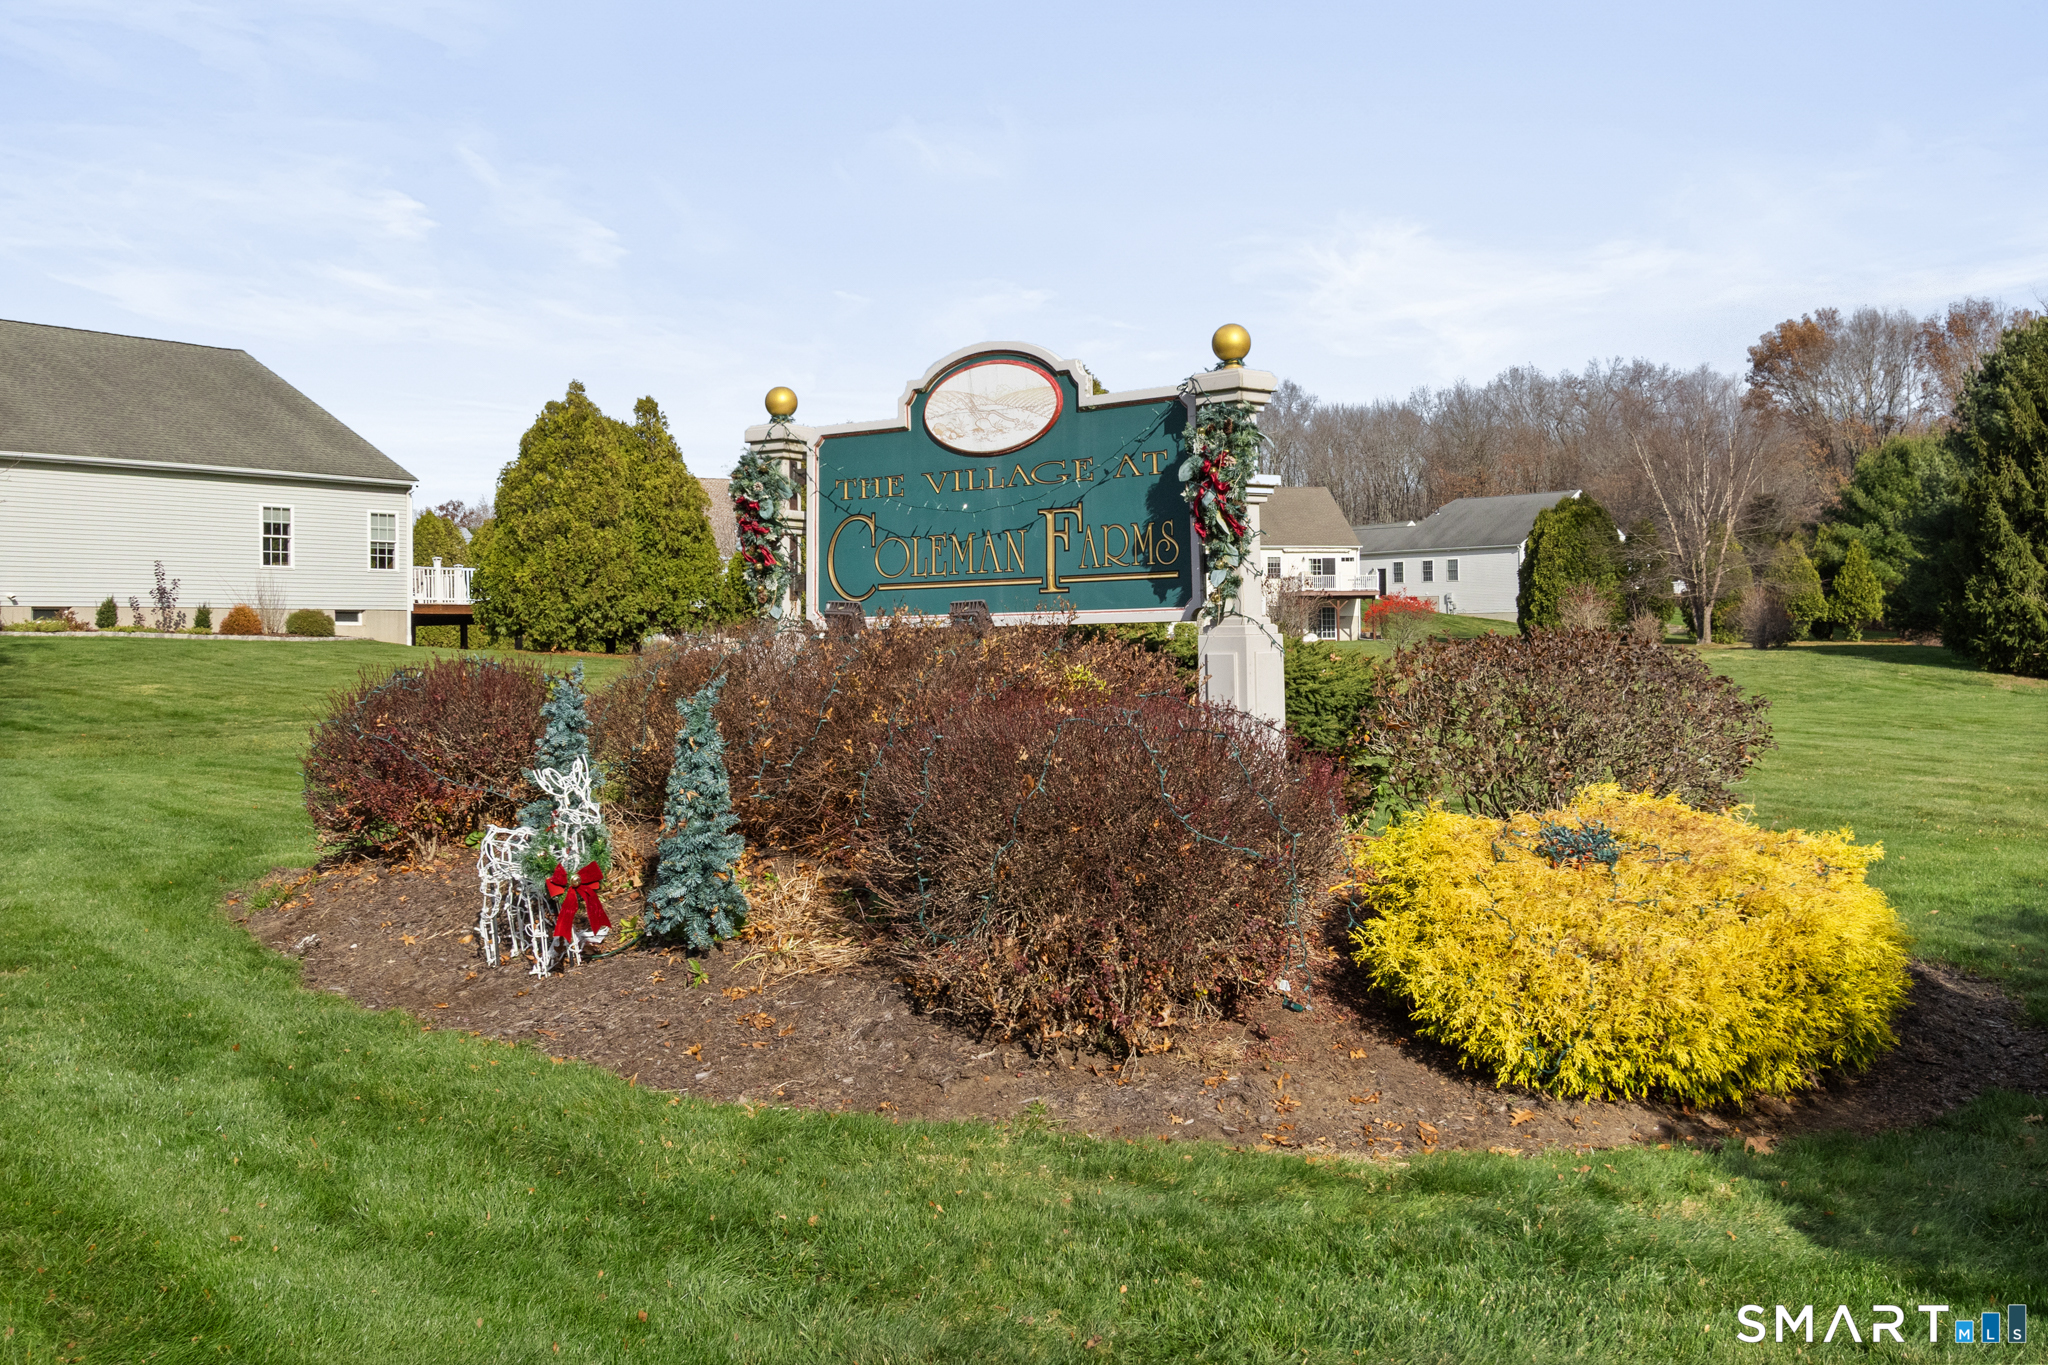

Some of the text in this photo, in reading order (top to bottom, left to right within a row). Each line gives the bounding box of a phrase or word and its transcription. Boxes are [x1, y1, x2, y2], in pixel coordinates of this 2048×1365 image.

[835, 449, 1168, 500] THE VILLAGE AT
[827, 502, 1180, 601] COLEMAN FARMS
